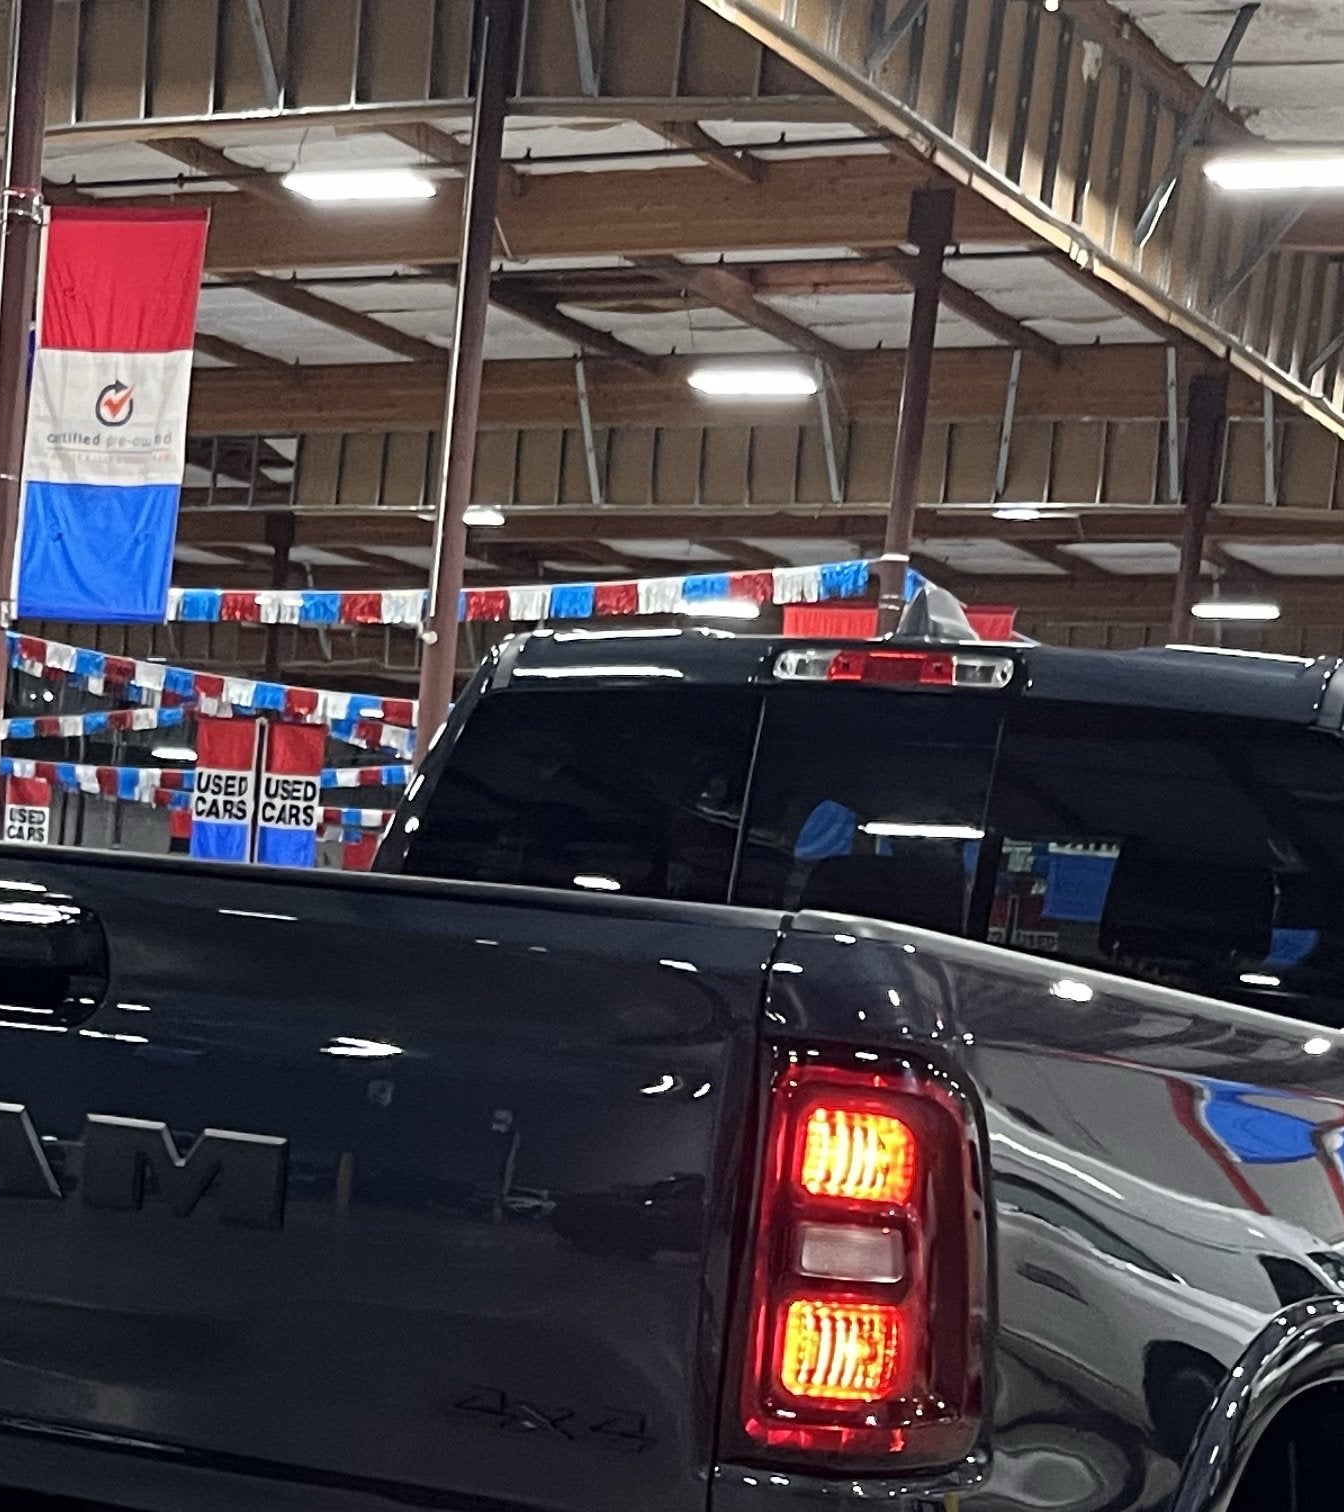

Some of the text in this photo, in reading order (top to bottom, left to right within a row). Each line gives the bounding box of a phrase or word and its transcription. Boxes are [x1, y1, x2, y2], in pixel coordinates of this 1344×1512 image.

[197, 772, 248, 797] USED
[265, 777, 317, 800] USED
[9, 809, 45, 825] USED
[195, 795, 248, 820] CARS
[261, 802, 315, 826] CARS
[7, 825, 45, 842] CARS
